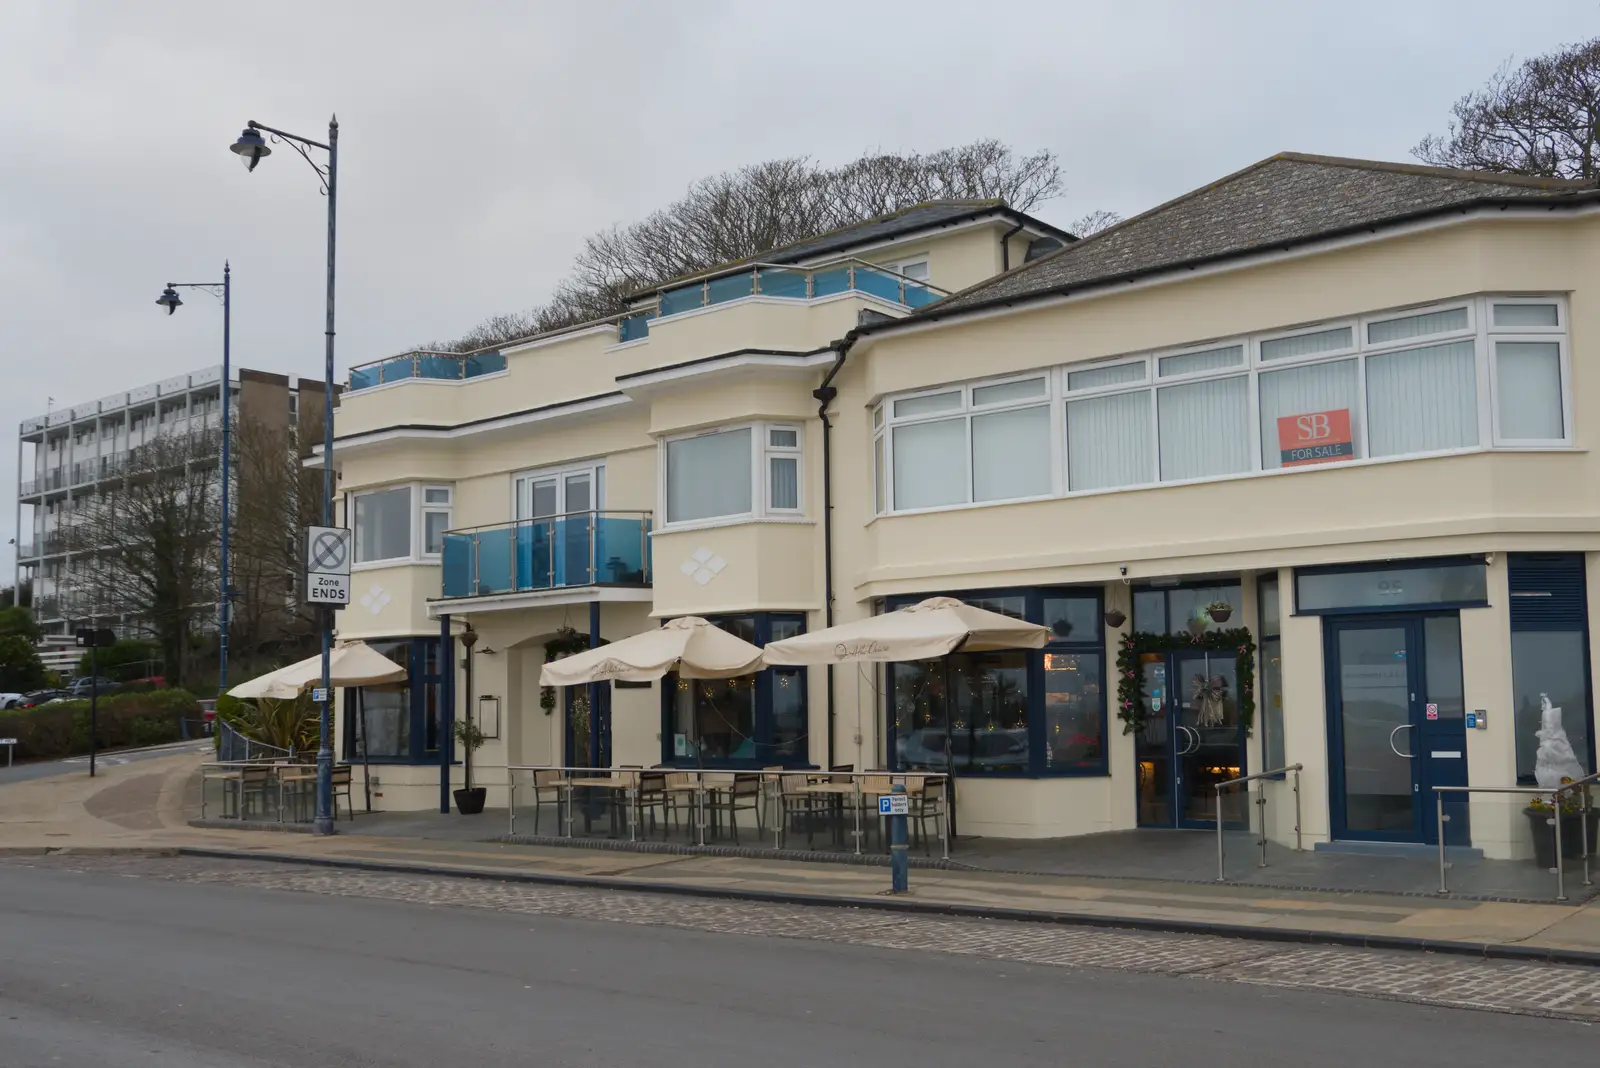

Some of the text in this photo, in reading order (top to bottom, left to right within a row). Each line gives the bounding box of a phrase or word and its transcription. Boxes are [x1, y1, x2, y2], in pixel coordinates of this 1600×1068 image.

[1297, 414, 1331, 440] SB
[1291, 444, 1342, 460] FOR SALE
[318, 577, 339, 586] Zone
[312, 588, 345, 599] ENDS
